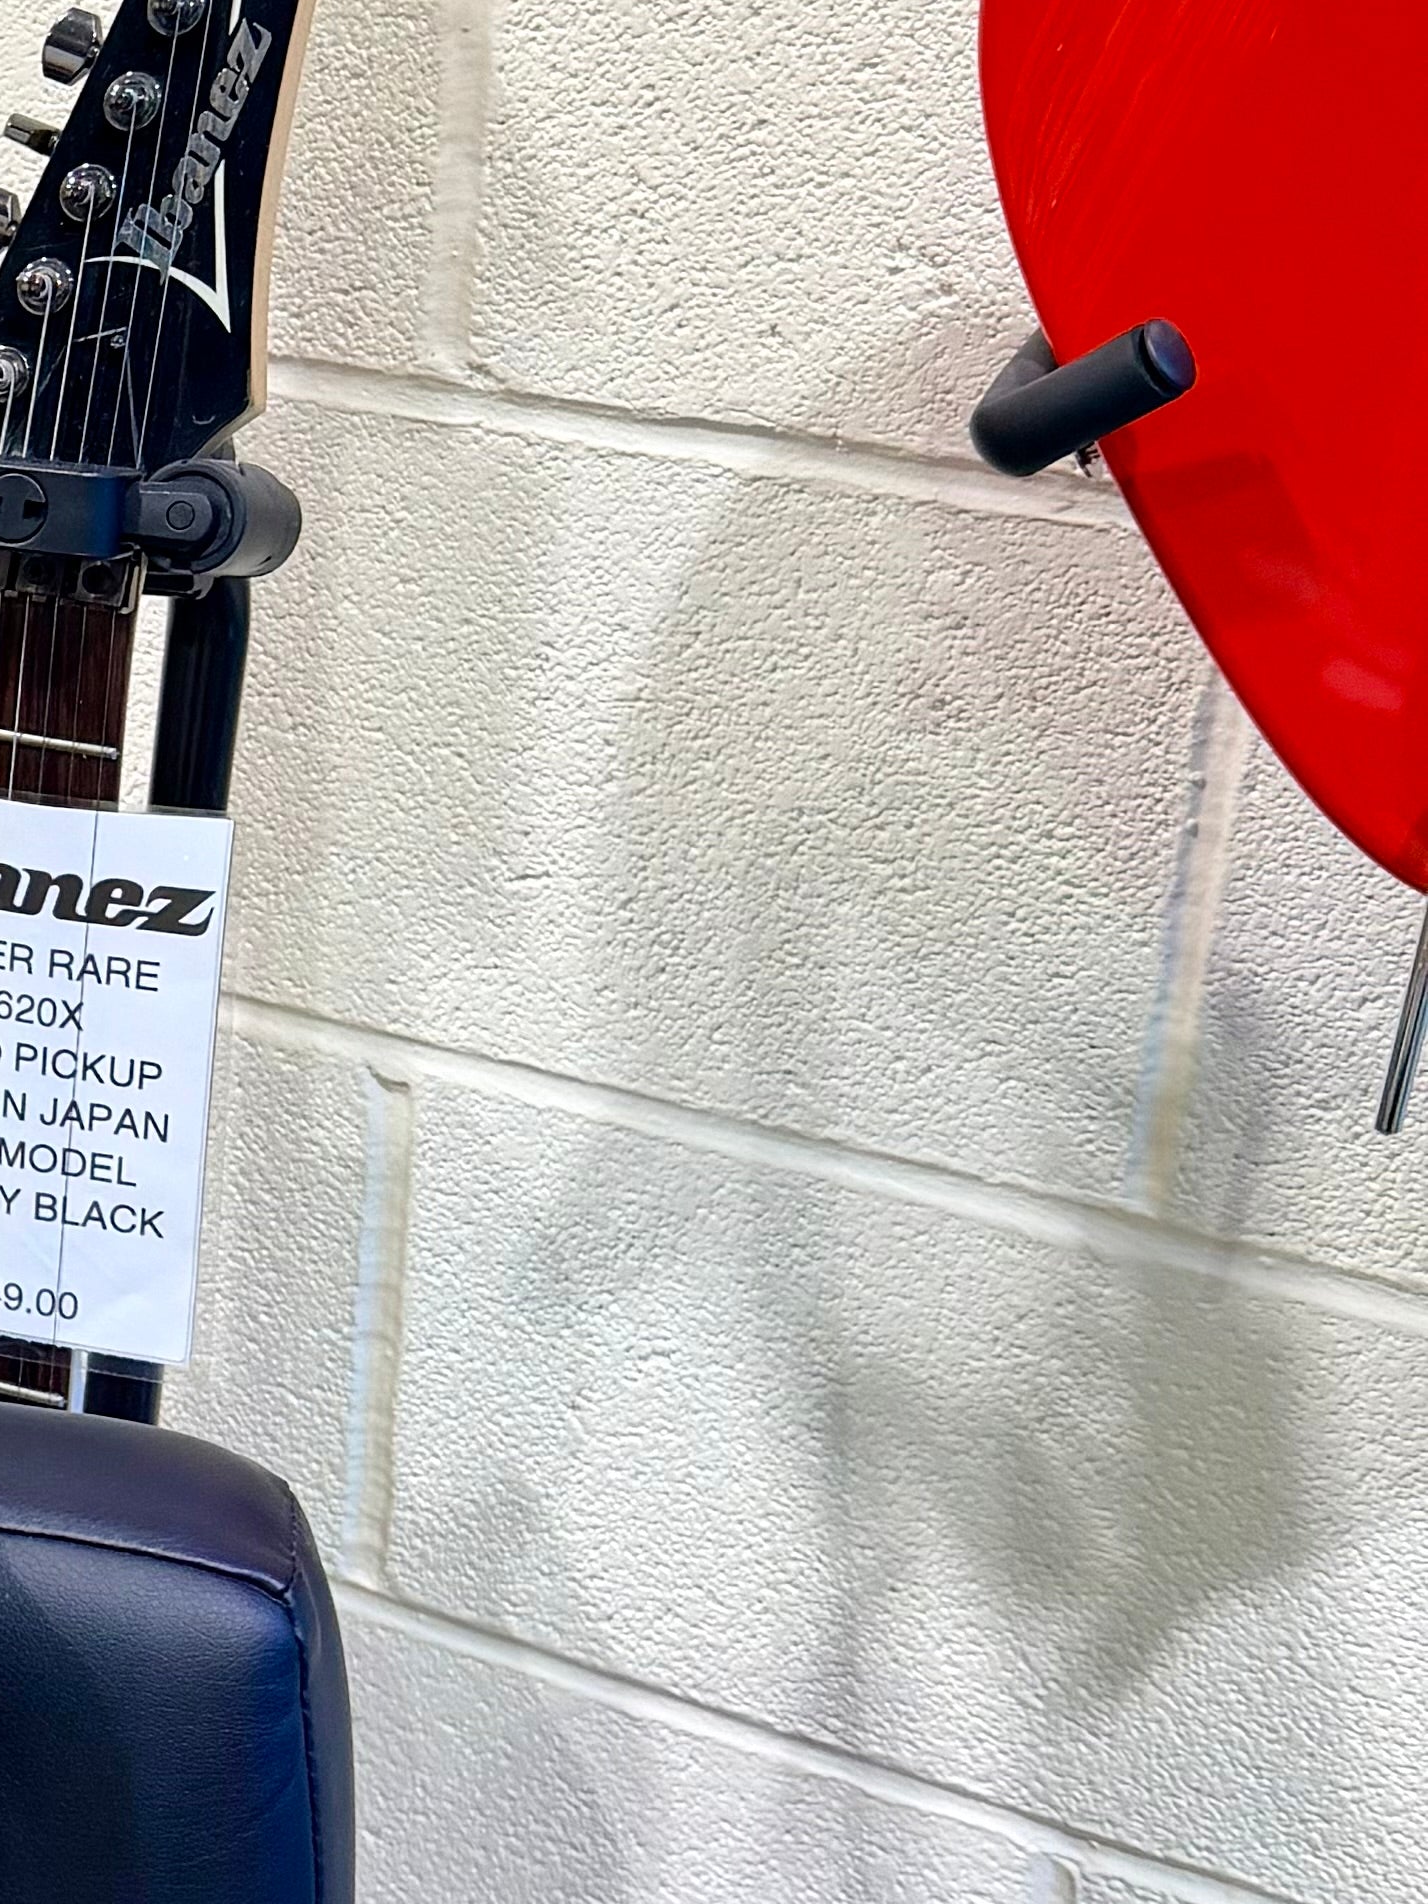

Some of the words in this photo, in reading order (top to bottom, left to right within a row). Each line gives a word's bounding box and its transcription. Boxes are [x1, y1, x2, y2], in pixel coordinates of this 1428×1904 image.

[113, 17, 272, 286] Ibanez
[47, 947, 162, 992] RARE
[14, 1039, 164, 1091] PICKUP
[39, 1098, 170, 1144] JAPAN
[33, 1192, 166, 1239] BLACK
